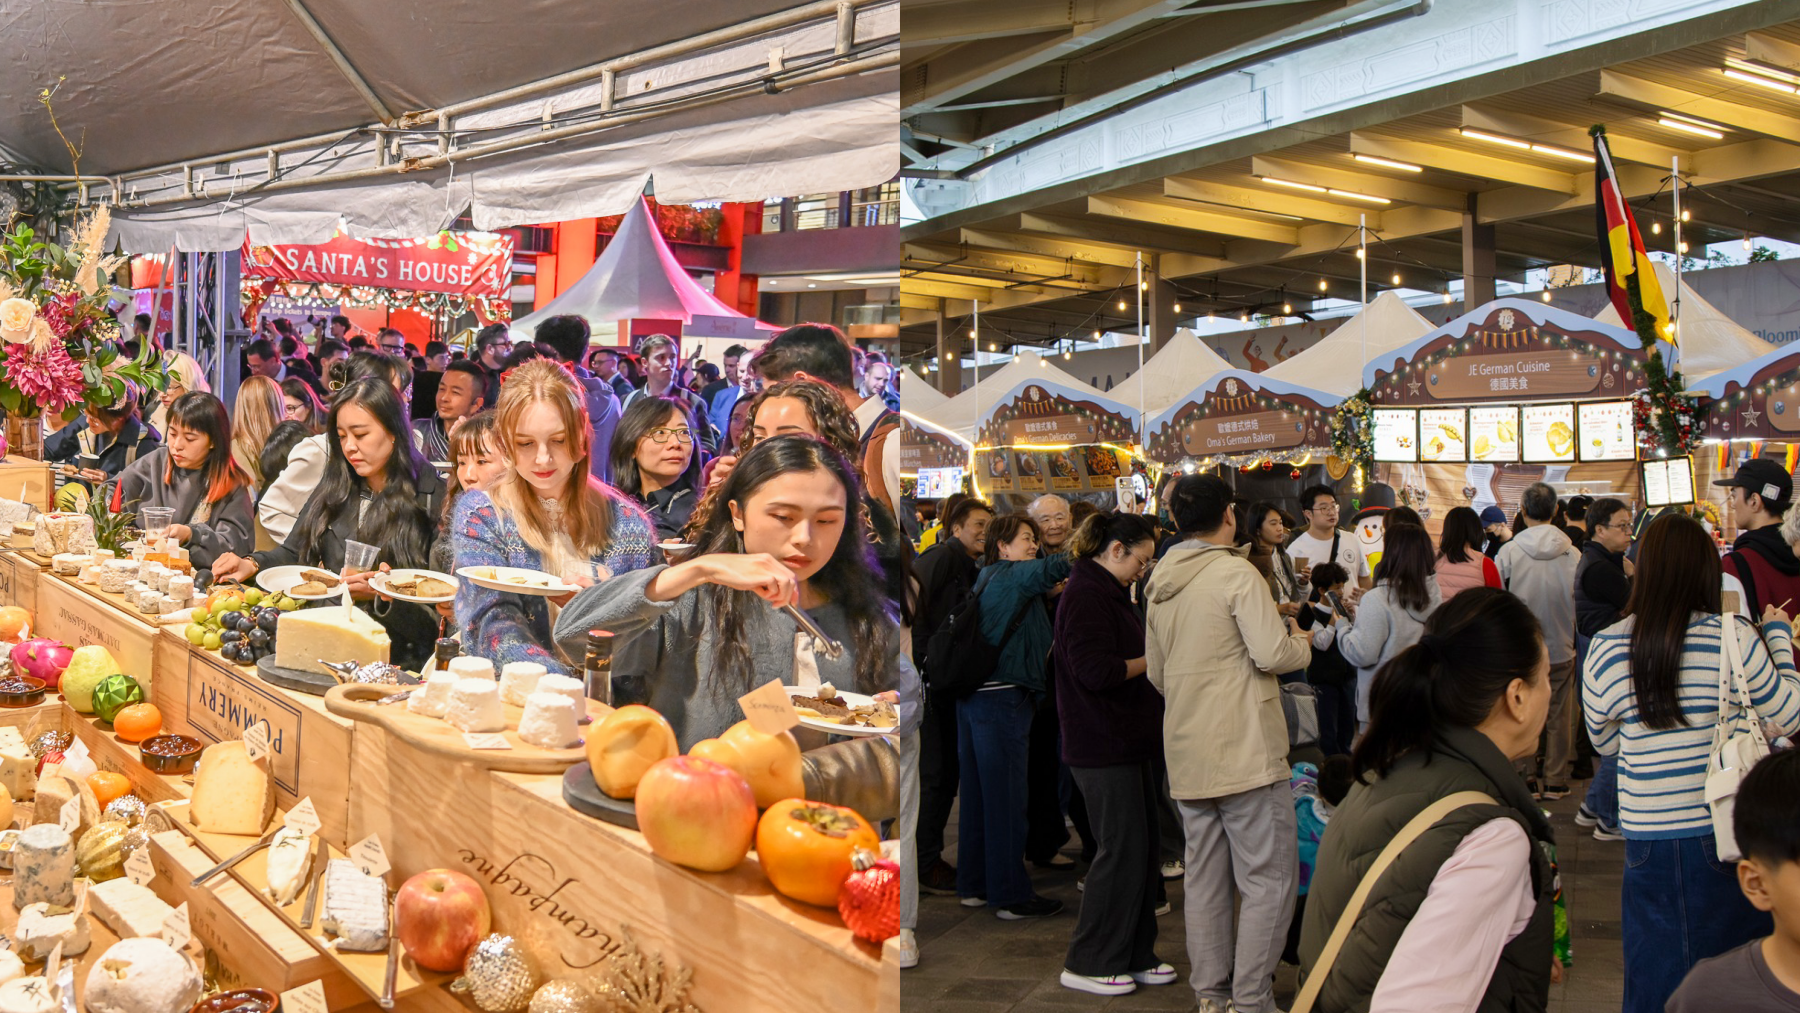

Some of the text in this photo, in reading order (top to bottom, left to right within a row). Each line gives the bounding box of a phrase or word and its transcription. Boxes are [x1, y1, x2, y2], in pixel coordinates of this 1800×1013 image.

[286, 248, 473, 287] SANTA'S HOUSE
[1502, 315, 1512, 325] 12
[1468, 361, 1550, 376] JE German Cuisine
[1490, 376, 1528, 391] 德國美食
[1013, 432, 1077, 444] Oma's German Delicacies
[1206, 432, 1276, 447] Oma's German Bakery
[58, 606, 87, 631] GASSAC
